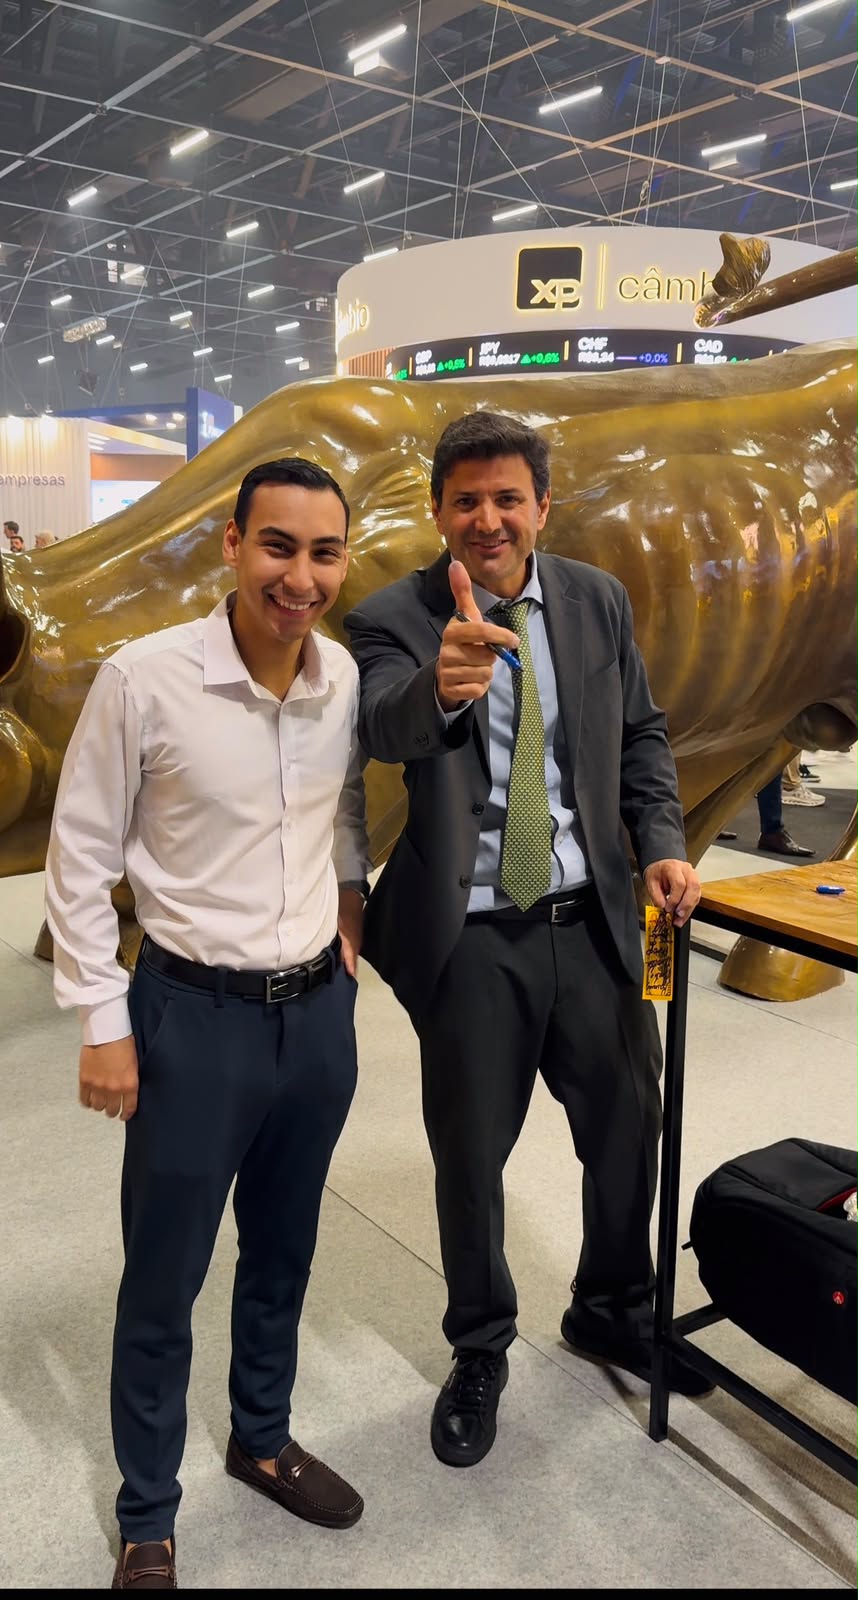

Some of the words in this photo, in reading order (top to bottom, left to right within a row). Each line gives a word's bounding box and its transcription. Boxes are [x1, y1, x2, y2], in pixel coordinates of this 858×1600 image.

[618, 267, 713, 301] câmb
[479, 341, 501, 356] JPY
[577, 336, 609, 351] CHF
[694, 338, 724, 354] CAD
[530, 352, 560, 365] +0,6%
[639, 353, 668, 364] +0,0%
[0, 475, 65, 489] empresas
